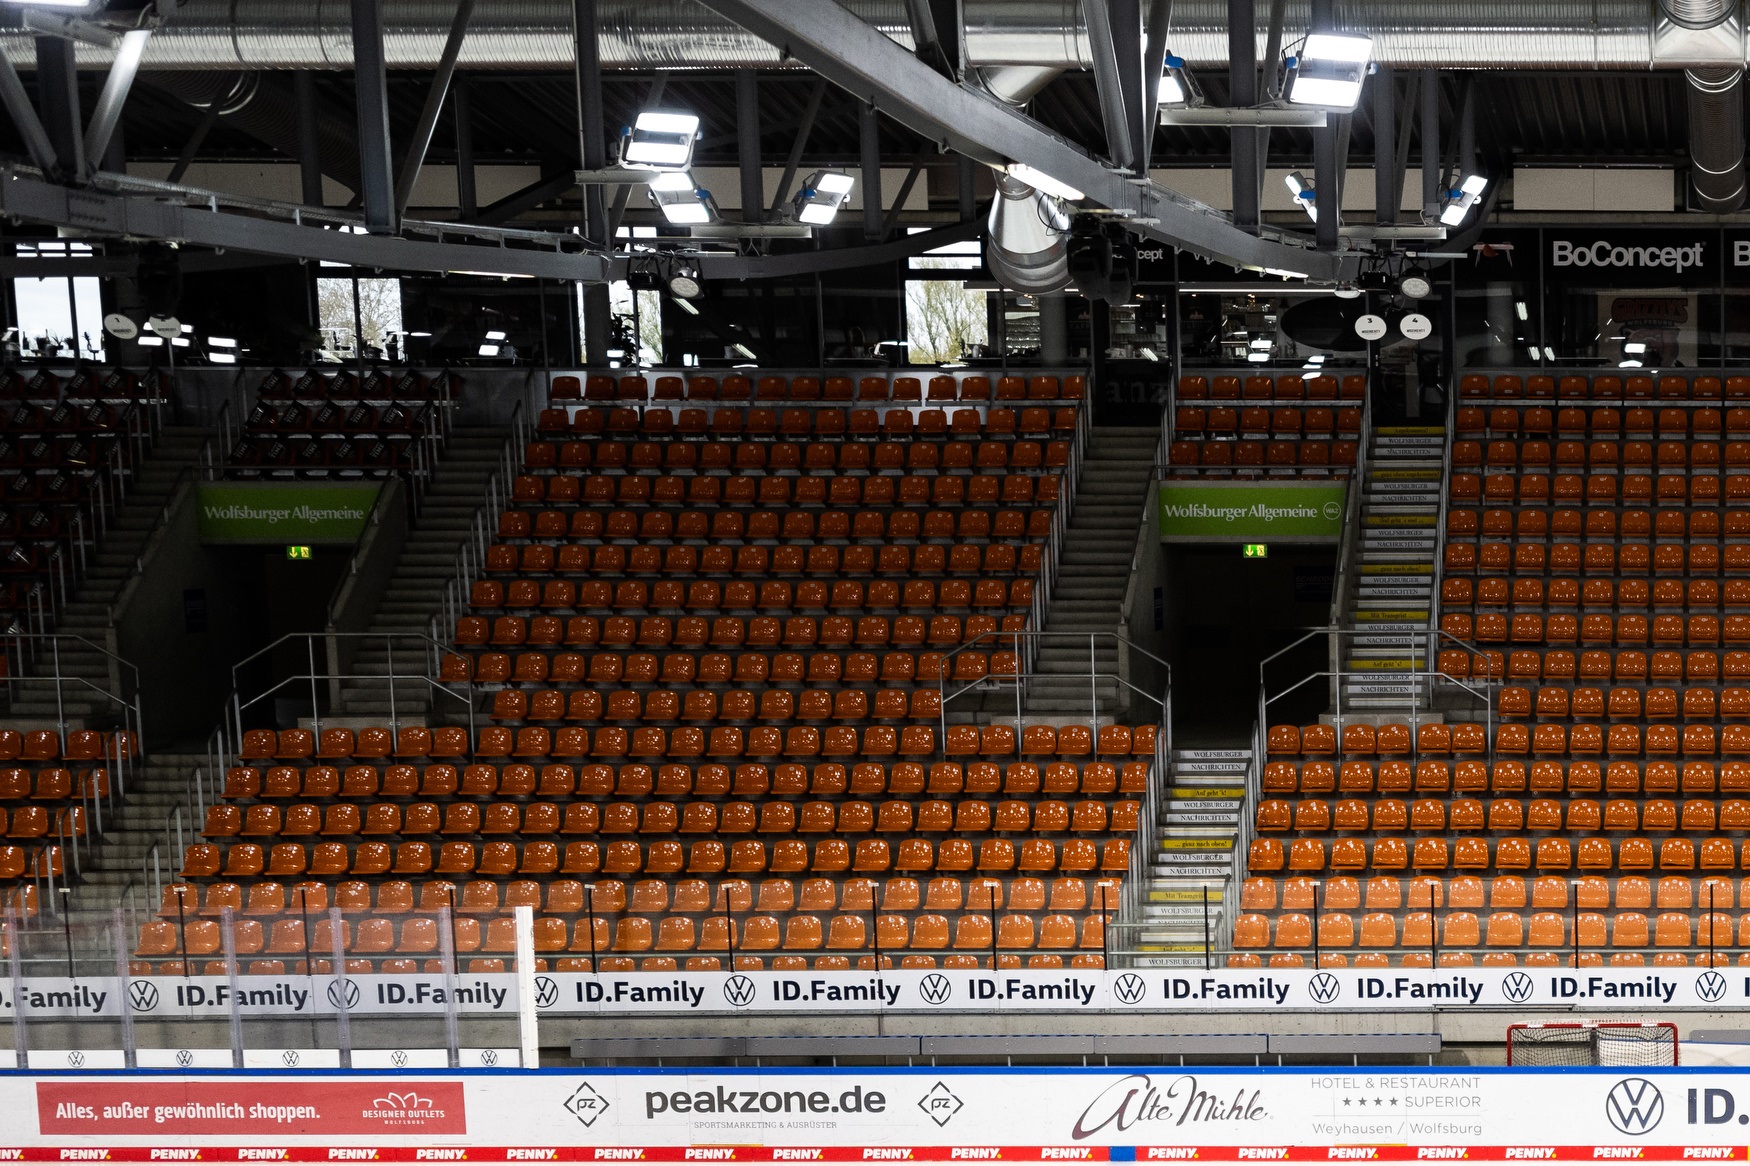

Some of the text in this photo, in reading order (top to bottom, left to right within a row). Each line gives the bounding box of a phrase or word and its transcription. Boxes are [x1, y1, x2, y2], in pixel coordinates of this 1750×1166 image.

[1553, 241, 1703, 273] BoConcept
[205, 504, 364, 524] Wolfsburger Allgemeine
[1164, 504, 1318, 522] Wolfsburger Allgemeine
[178, 983, 308, 1011] ID.Family
[378, 982, 507, 1010] ID.Family
[577, 981, 705, 1008] ID.Family
[774, 979, 901, 1006] ID.Family
[970, 978, 1095, 1005] ID.Family
[1164, 978, 1289, 1004] ID.Family
[1359, 977, 1483, 1004] ID.Family
[1552, 977, 1676, 1004] ID.Family
[1311, 1076, 1481, 1089] HOTEL & RESTAURANT
[57, 1101, 321, 1122] Alles, außer gewöhnlich shoppen.
[362, 1110, 445, 1118] DESIGNER OUTLETS
[646, 1085, 886, 1119] peakzone.de
[1405, 1096, 1482, 1108] SUPERIOR
[786, 1120, 838, 1129] AUSRÜSTER
[1312, 1122, 1482, 1137] Weyhausen / Wolfsburg
